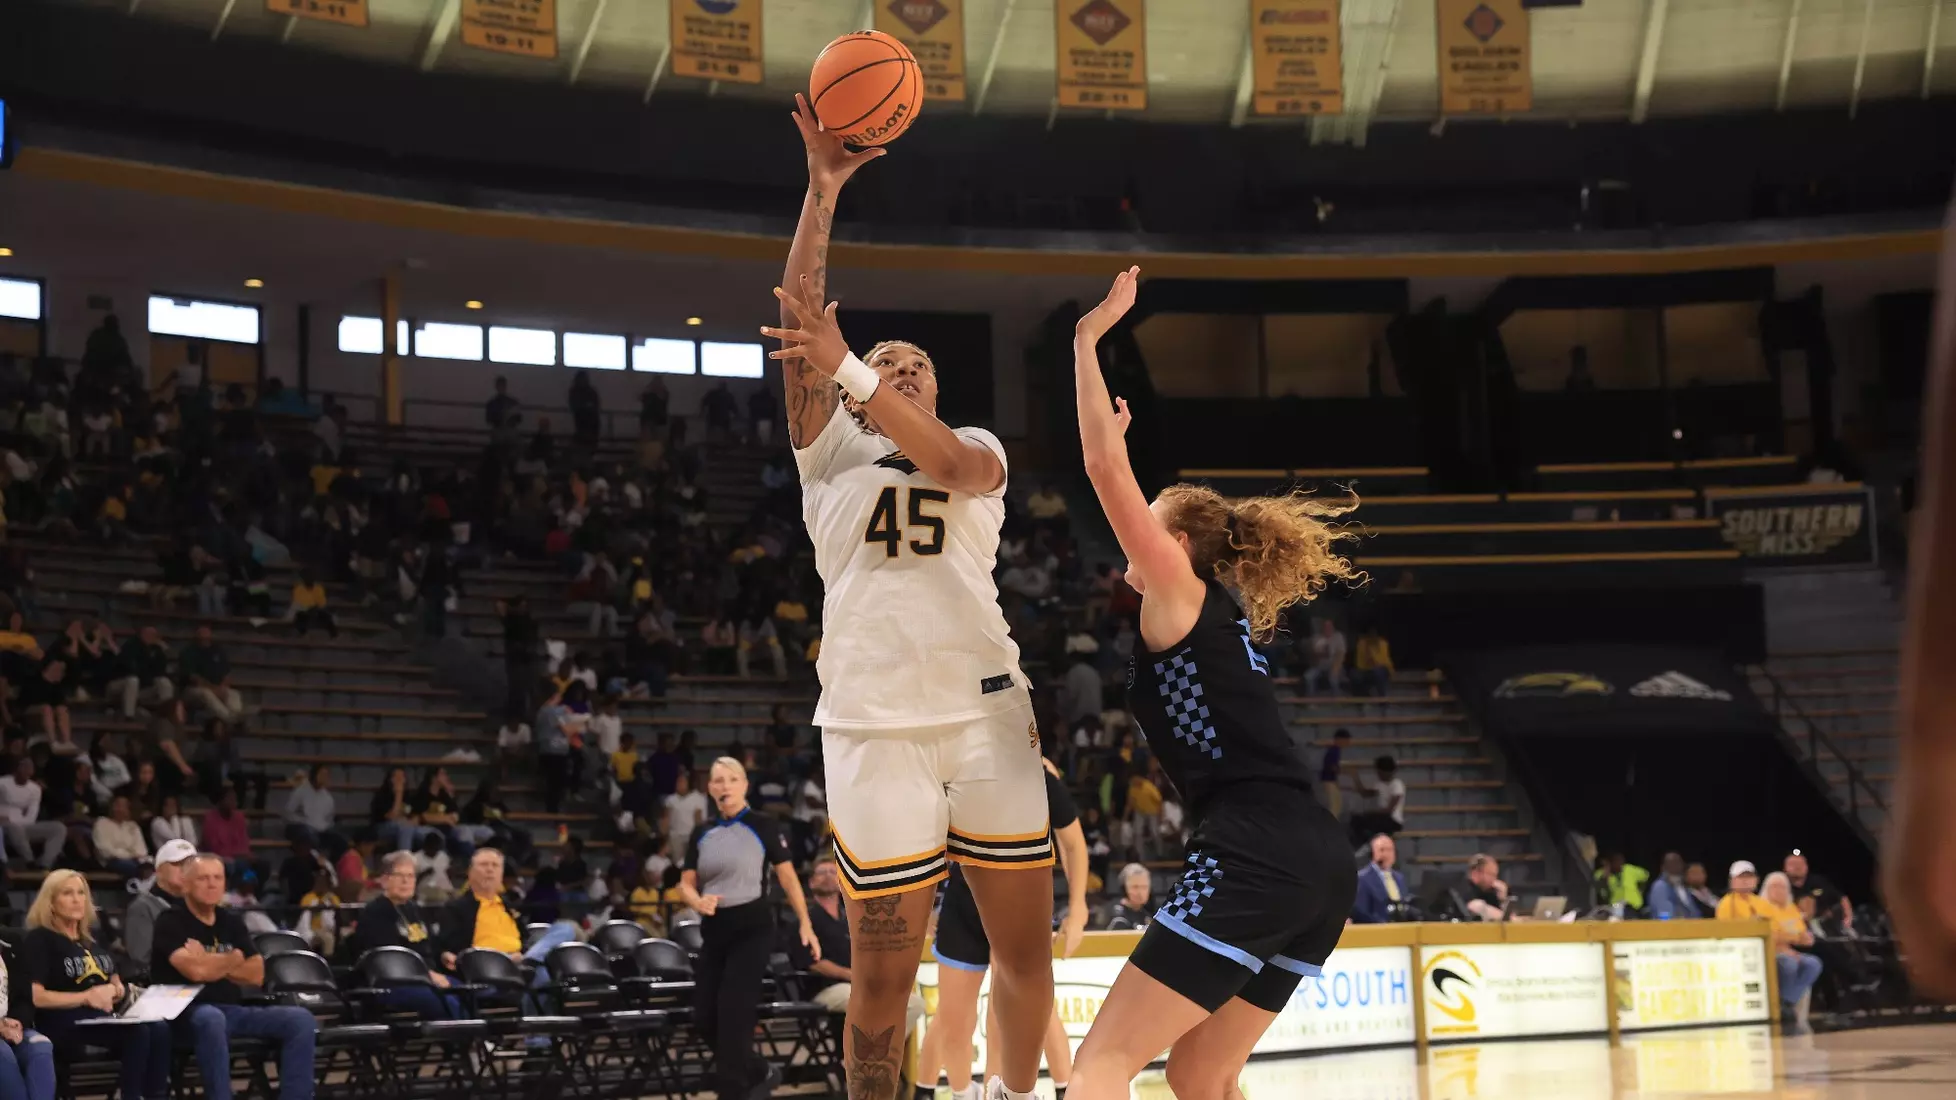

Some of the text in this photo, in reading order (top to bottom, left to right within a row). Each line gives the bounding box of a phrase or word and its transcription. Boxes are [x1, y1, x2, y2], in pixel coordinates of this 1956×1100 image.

[840, 103, 907, 144] Wilson
[864, 486, 952, 558] 45
[1722, 504, 1863, 535] SOUTHERN
[1290, 970, 1408, 1010] RSOUTH
